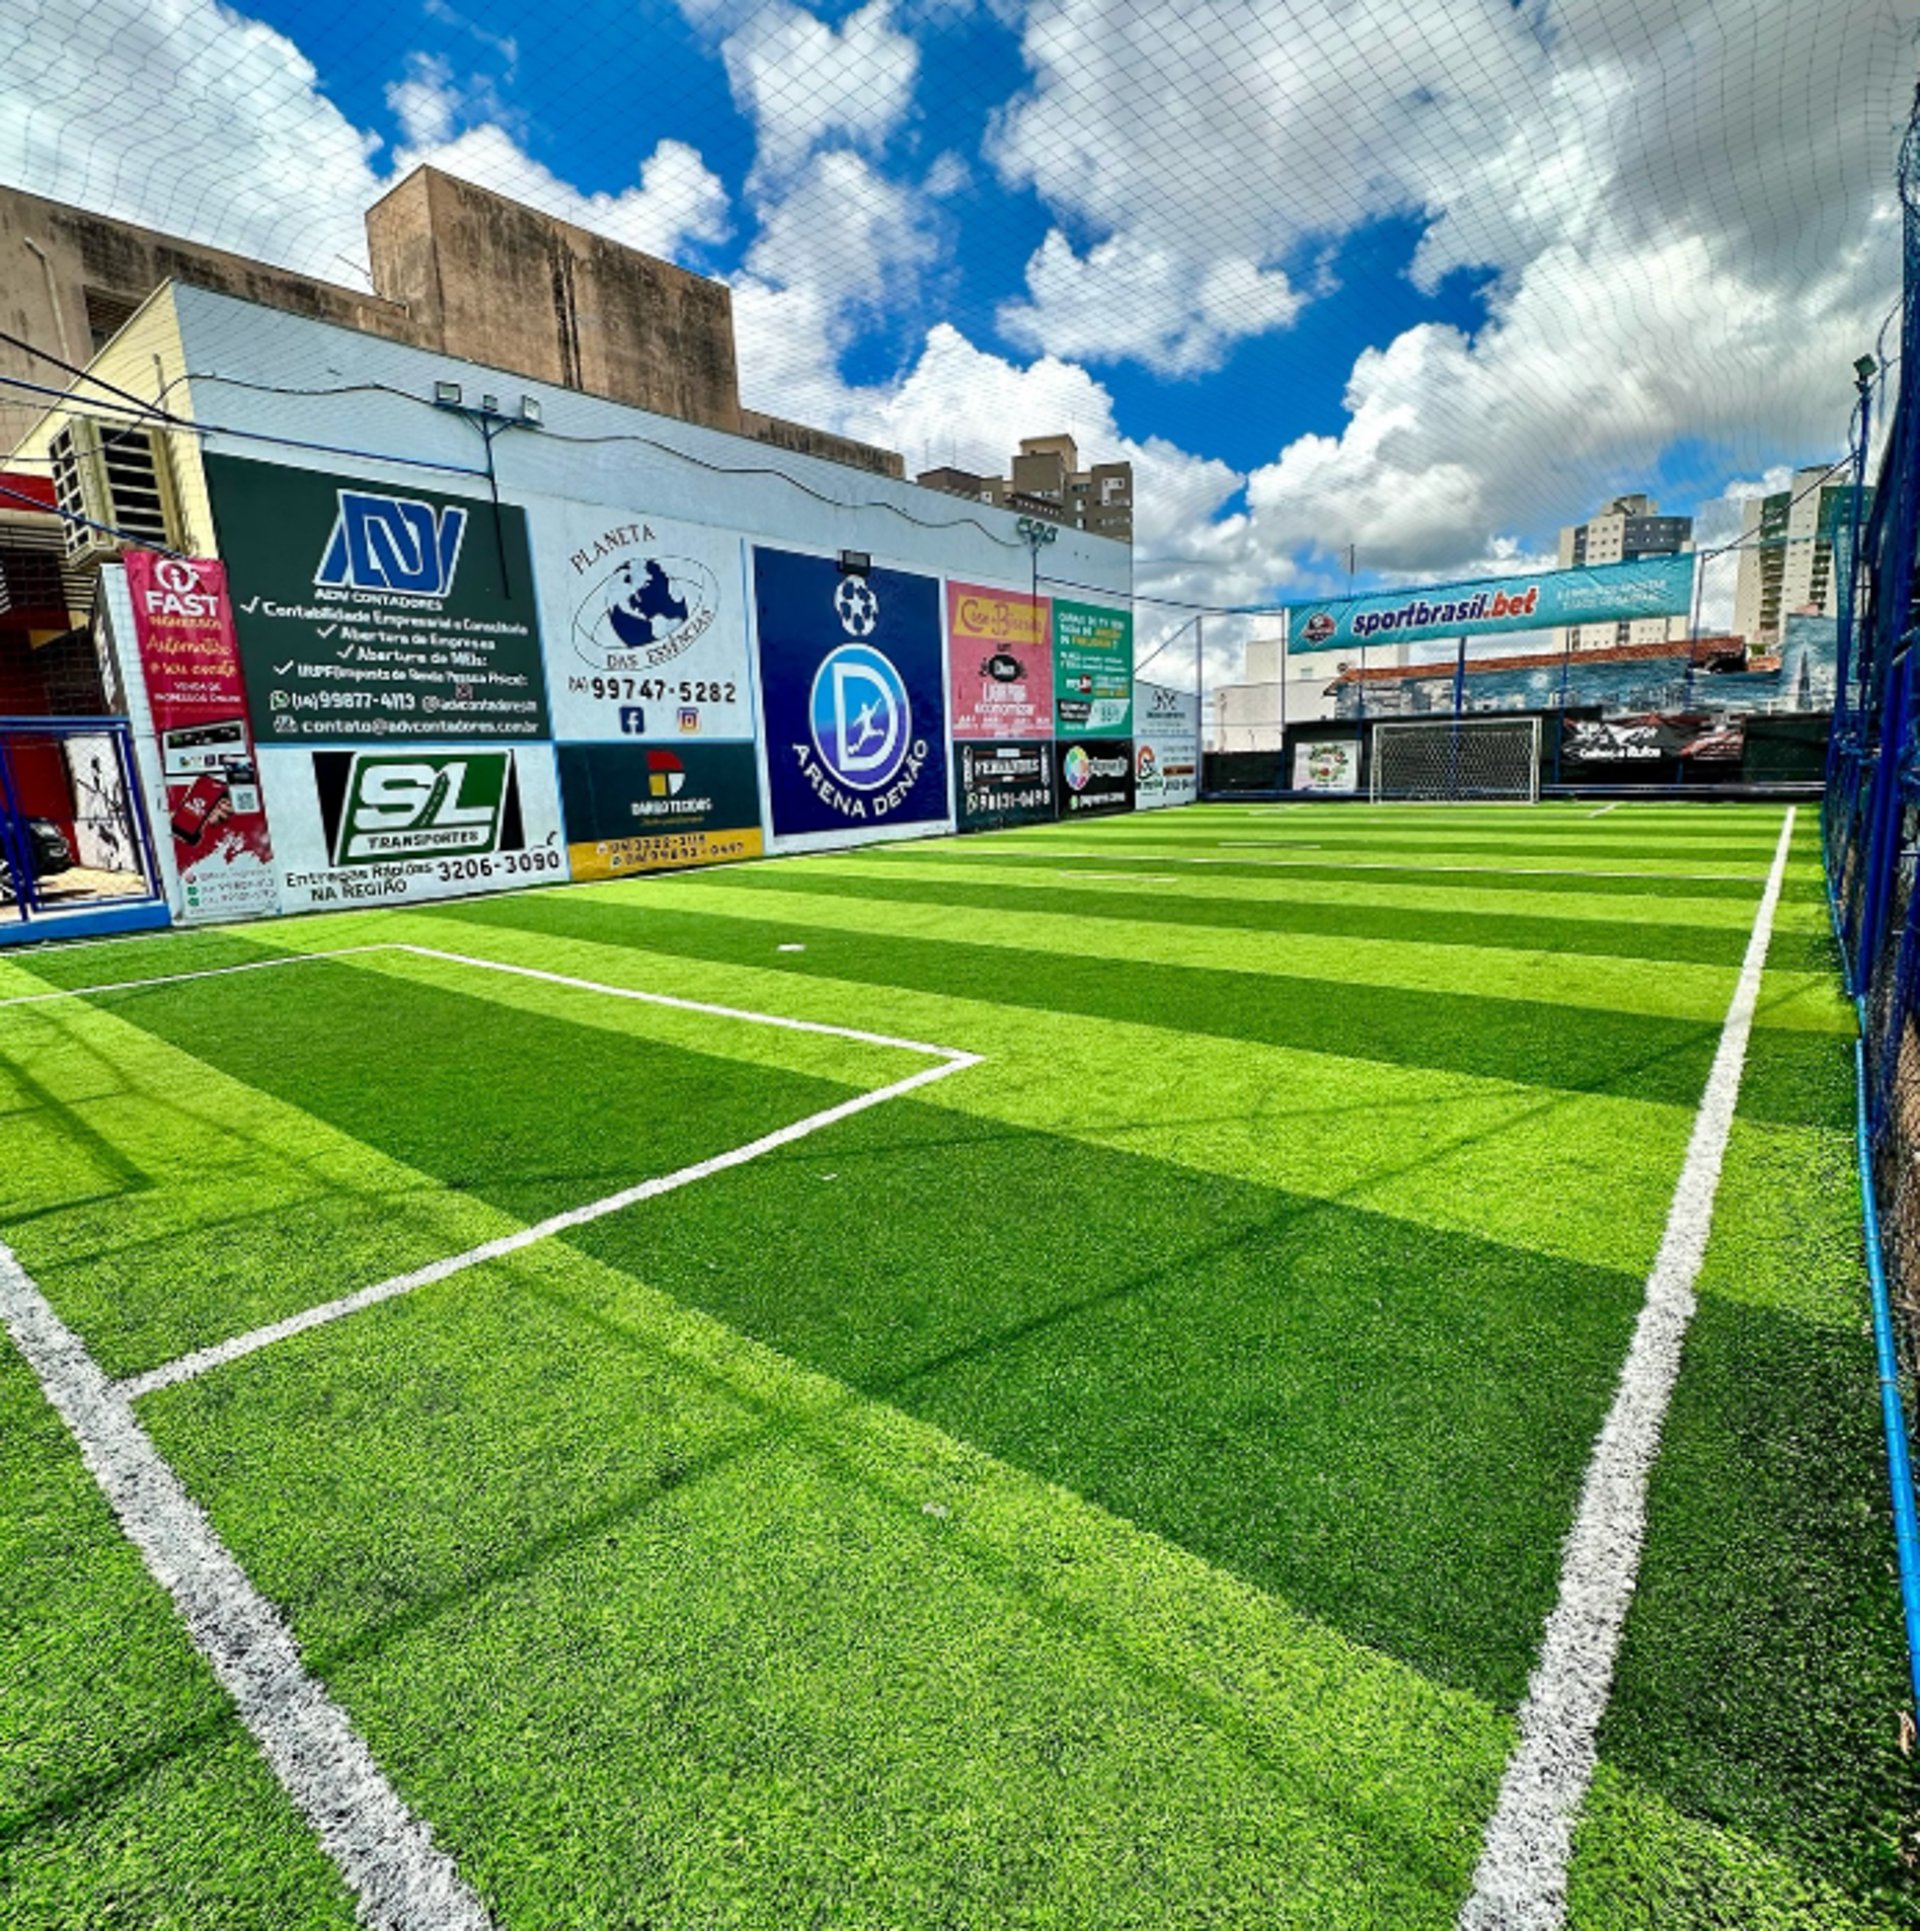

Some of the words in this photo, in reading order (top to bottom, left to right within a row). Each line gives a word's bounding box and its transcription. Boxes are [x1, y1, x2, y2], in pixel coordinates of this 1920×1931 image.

[569, 524, 656, 575] PLANETA
[146, 590, 219, 617] FAST
[262, 602, 371, 623] Contabilidade
[352, 591, 443, 612] CONTADORES
[1352, 587, 1537, 636] sportbrasil.bet
[606, 653, 639, 669] DAS
[792, 743, 867, 818] ARENA
[873, 738, 929, 817] DENÃO
[353, 762, 495, 830] SL
[367, 831, 479, 850] TRANSPORTES
[286, 869, 369, 888] Entregas
[437, 850, 560, 882] 3206-3090
[311, 888, 338, 902] NA
[341, 877, 407, 899] REGIÃO
